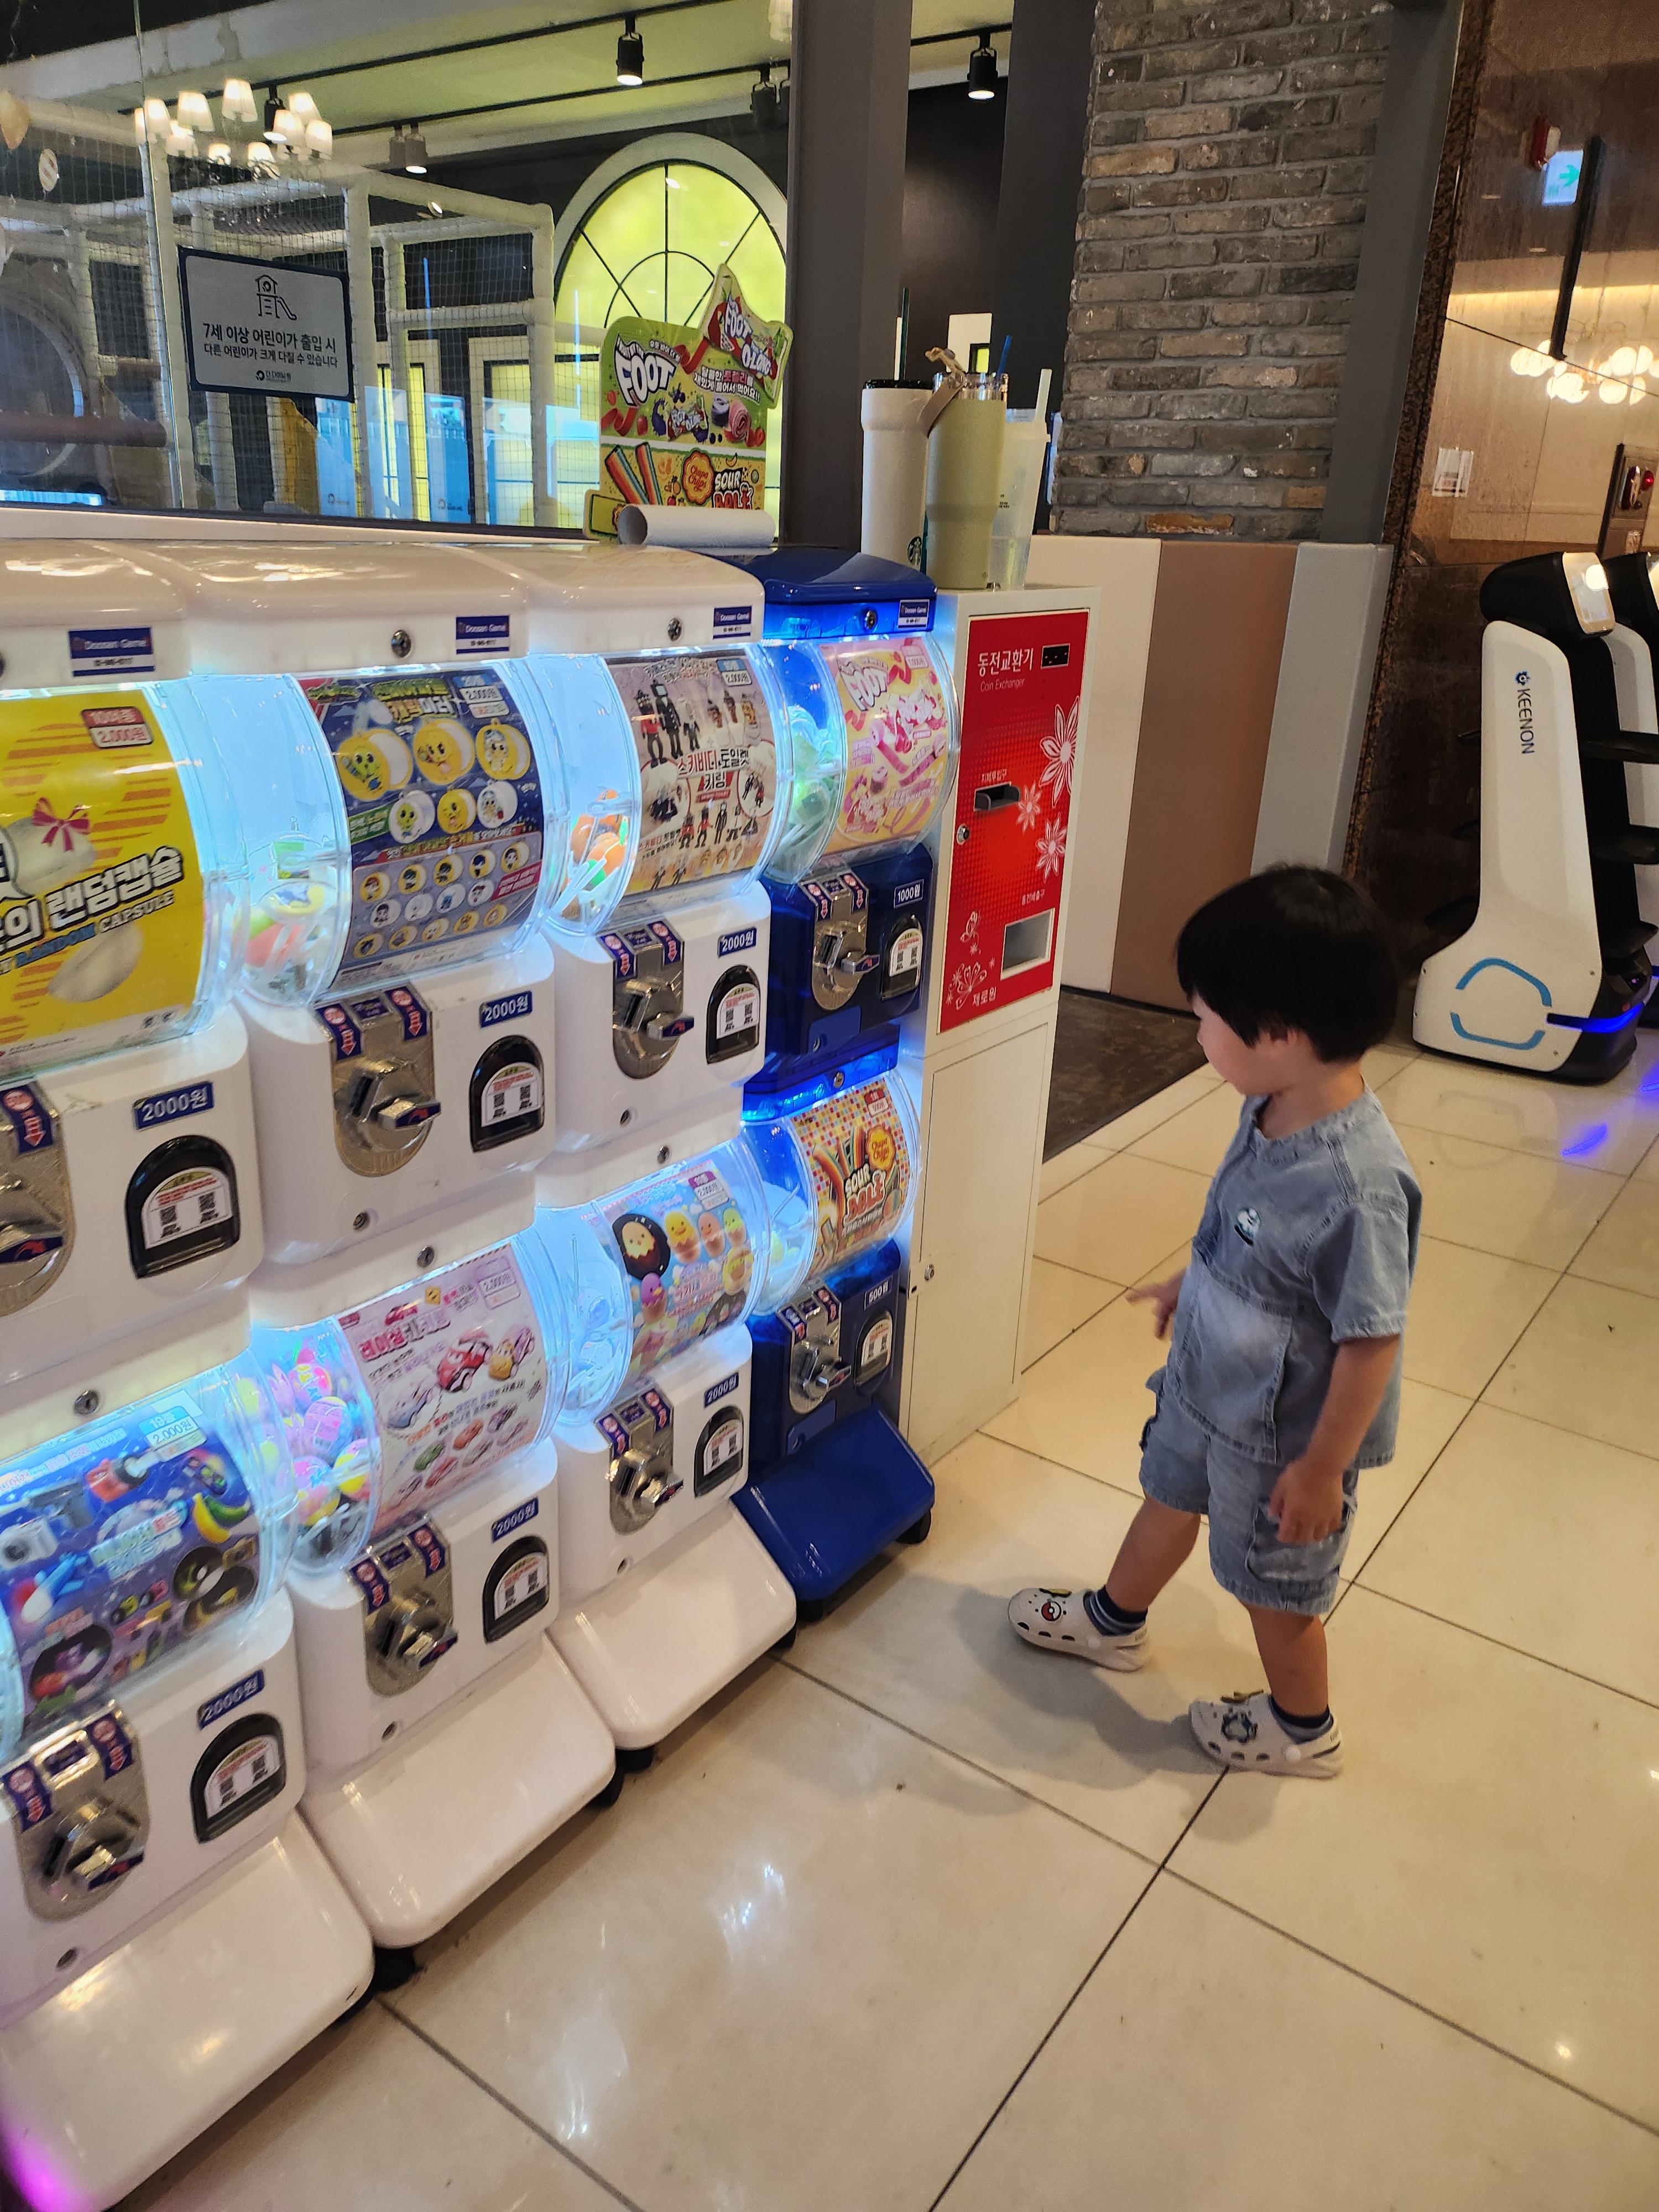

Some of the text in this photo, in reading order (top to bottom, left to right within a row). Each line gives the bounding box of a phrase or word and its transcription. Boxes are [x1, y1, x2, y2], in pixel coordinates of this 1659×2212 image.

[203, 323, 336, 353] 7세 이상 어린이가 출입 시
[204, 343, 338, 368] 다른 어린이가 크게 다칠 수 있습니다
[615, 352, 677, 405] FOOT
[715, 471, 741, 491] SOUR
[978, 648, 1034, 677] 동전교환기
[980, 677, 1025, 692] Coin Exchanger
[1517, 688, 1535, 754] KEENON
[677, 748, 750, 775] 스키비디 토일렛
[705, 771, 726, 790] 키링
[45, 847, 184, 931] 랜덤캡슐
[897, 883, 920, 902] 1000원
[100, 889, 176, 933] CAPSULE
[721, 930, 754, 953] 2000원
[483, 994, 529, 1023] 2000원
[142, 1086, 208, 1123] 2000원
[871, 1138, 888, 1152] Chupa
[845, 1163, 870, 1197] SOUR
[707, 1374, 737, 1403] 2000원
[152, 1419, 195, 1445] 2,000원
[496, 1502, 536, 1537] 2000원
[202, 1678, 259, 1721] 2000원
